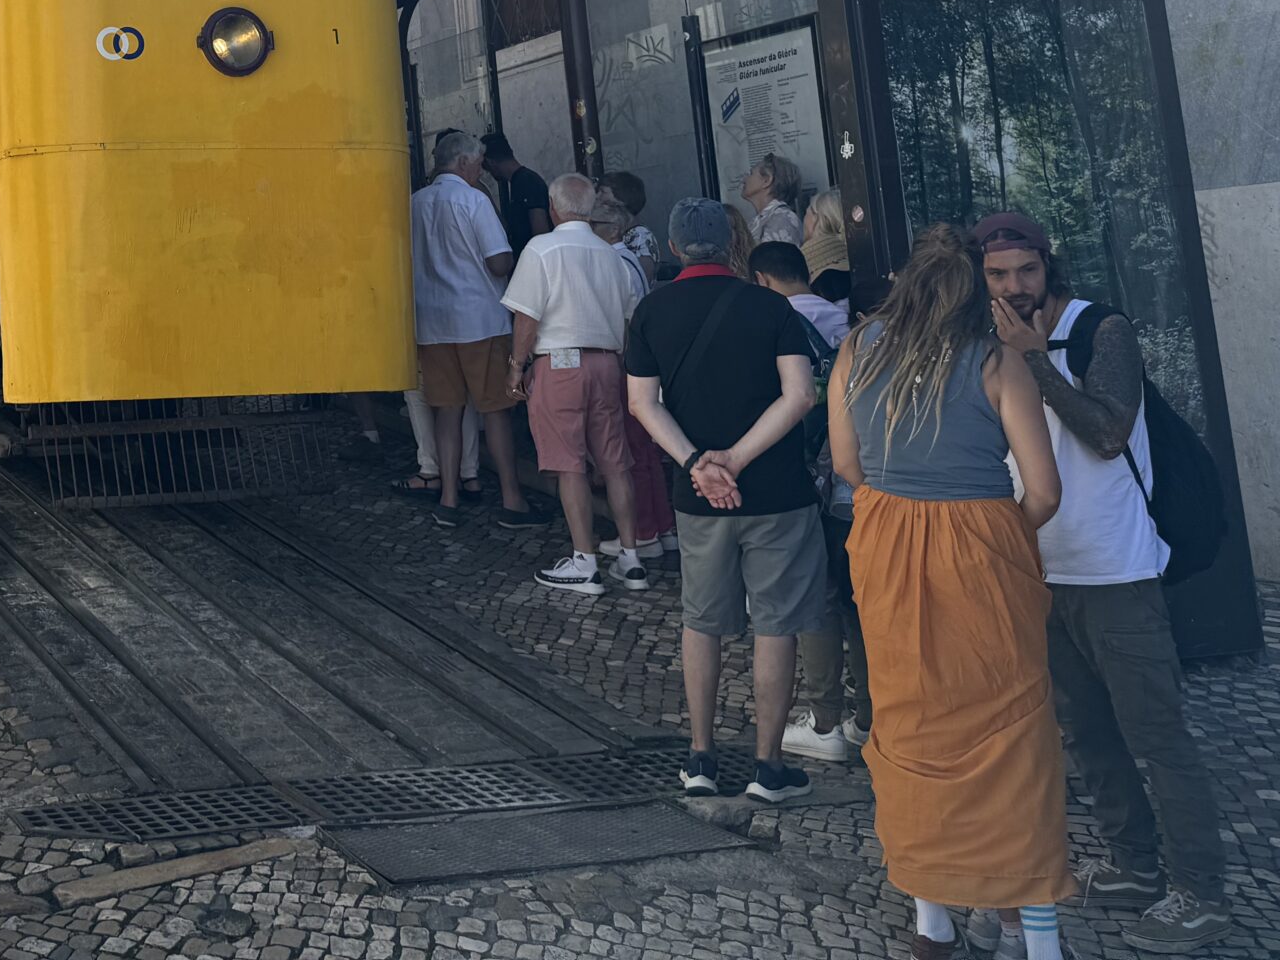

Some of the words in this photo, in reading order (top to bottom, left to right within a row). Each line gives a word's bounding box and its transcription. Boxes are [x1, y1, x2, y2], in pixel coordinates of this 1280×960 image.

[332, 28, 340, 45] 1
[738, 55, 768, 69] Ascensor
[768, 52, 777, 61] da
[777, 47, 798, 60] Glória
[739, 69, 759, 80] Glória
[759, 63, 787, 76] funicular
